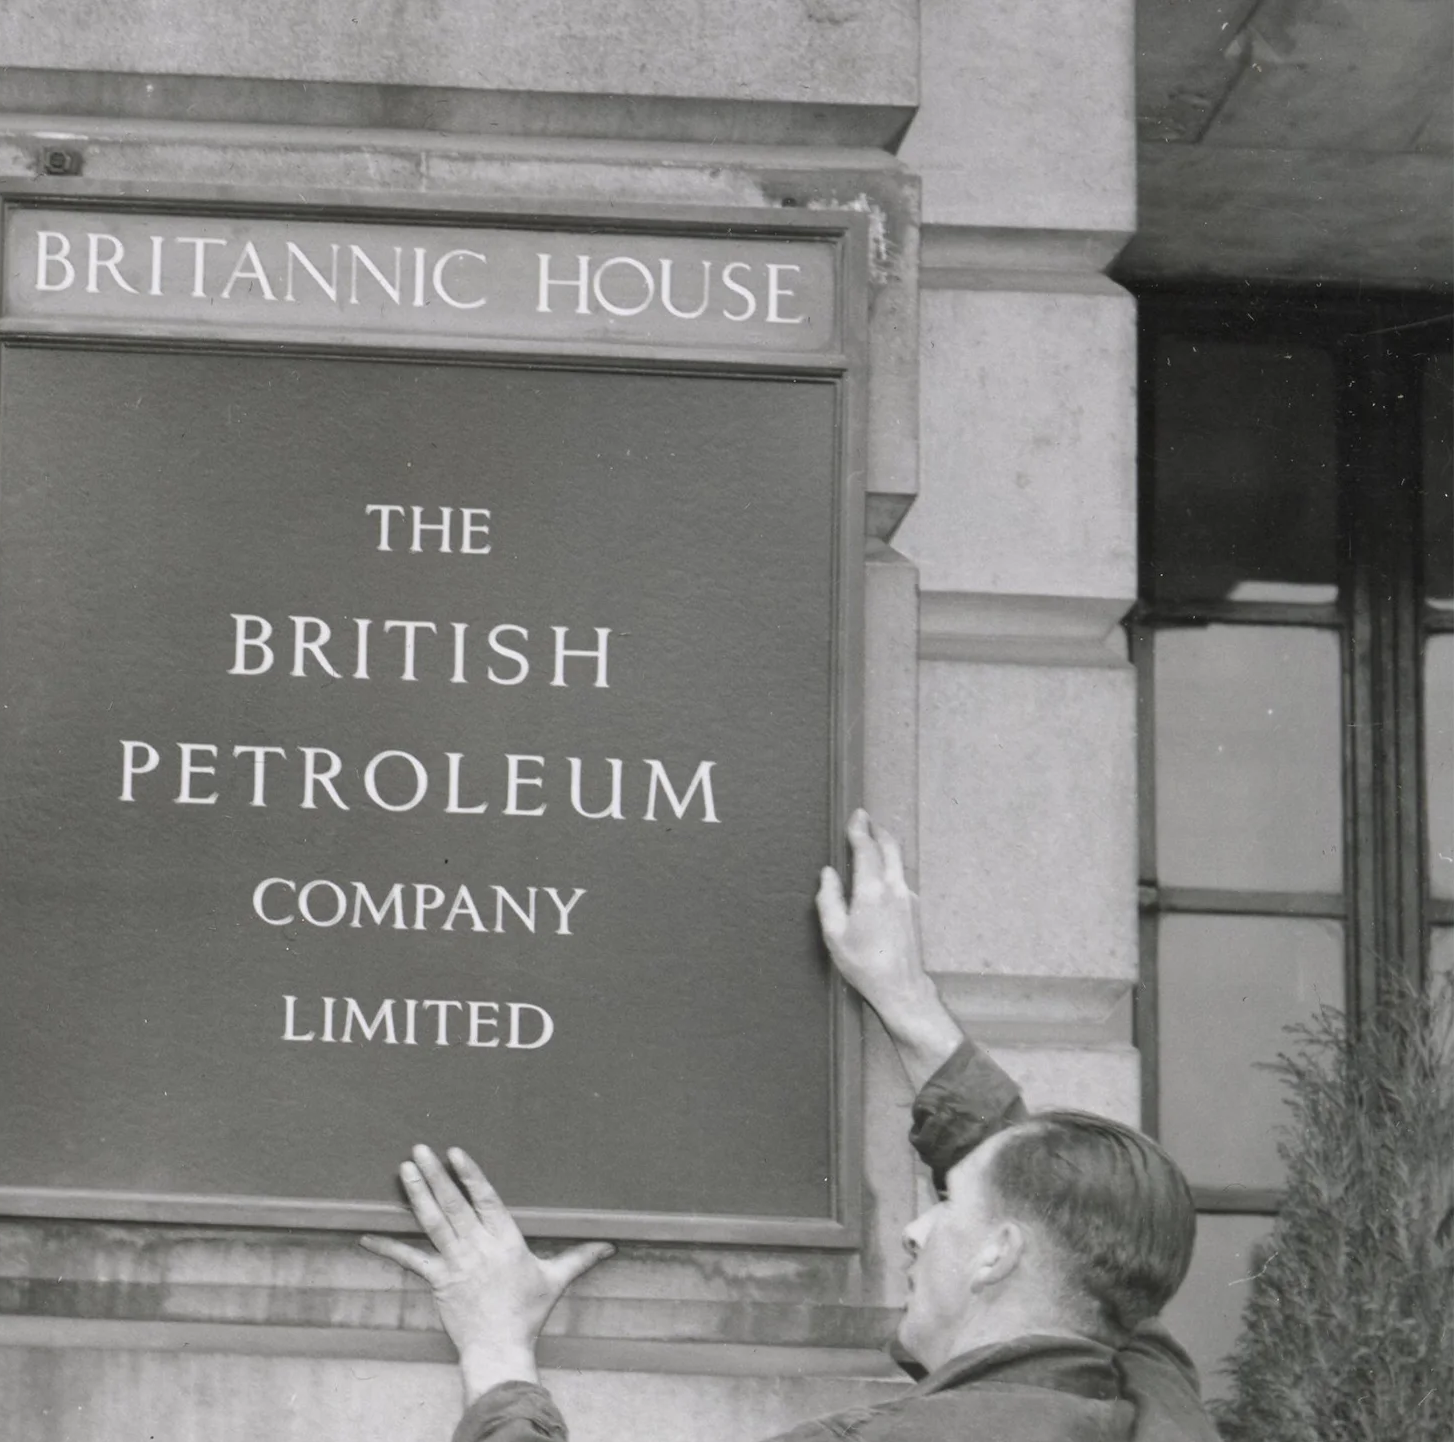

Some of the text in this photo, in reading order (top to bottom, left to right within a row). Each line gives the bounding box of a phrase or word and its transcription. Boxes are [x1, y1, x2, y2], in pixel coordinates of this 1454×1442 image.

[34, 231, 804, 324] BRITANNIC HOUSE
[365, 504, 492, 555] THE
[227, 613, 613, 688] BRITISH
[118, 740, 722, 824] PETROLEUM
[252, 877, 587, 936] COMPANY
[281, 995, 555, 1050] LIMITED
